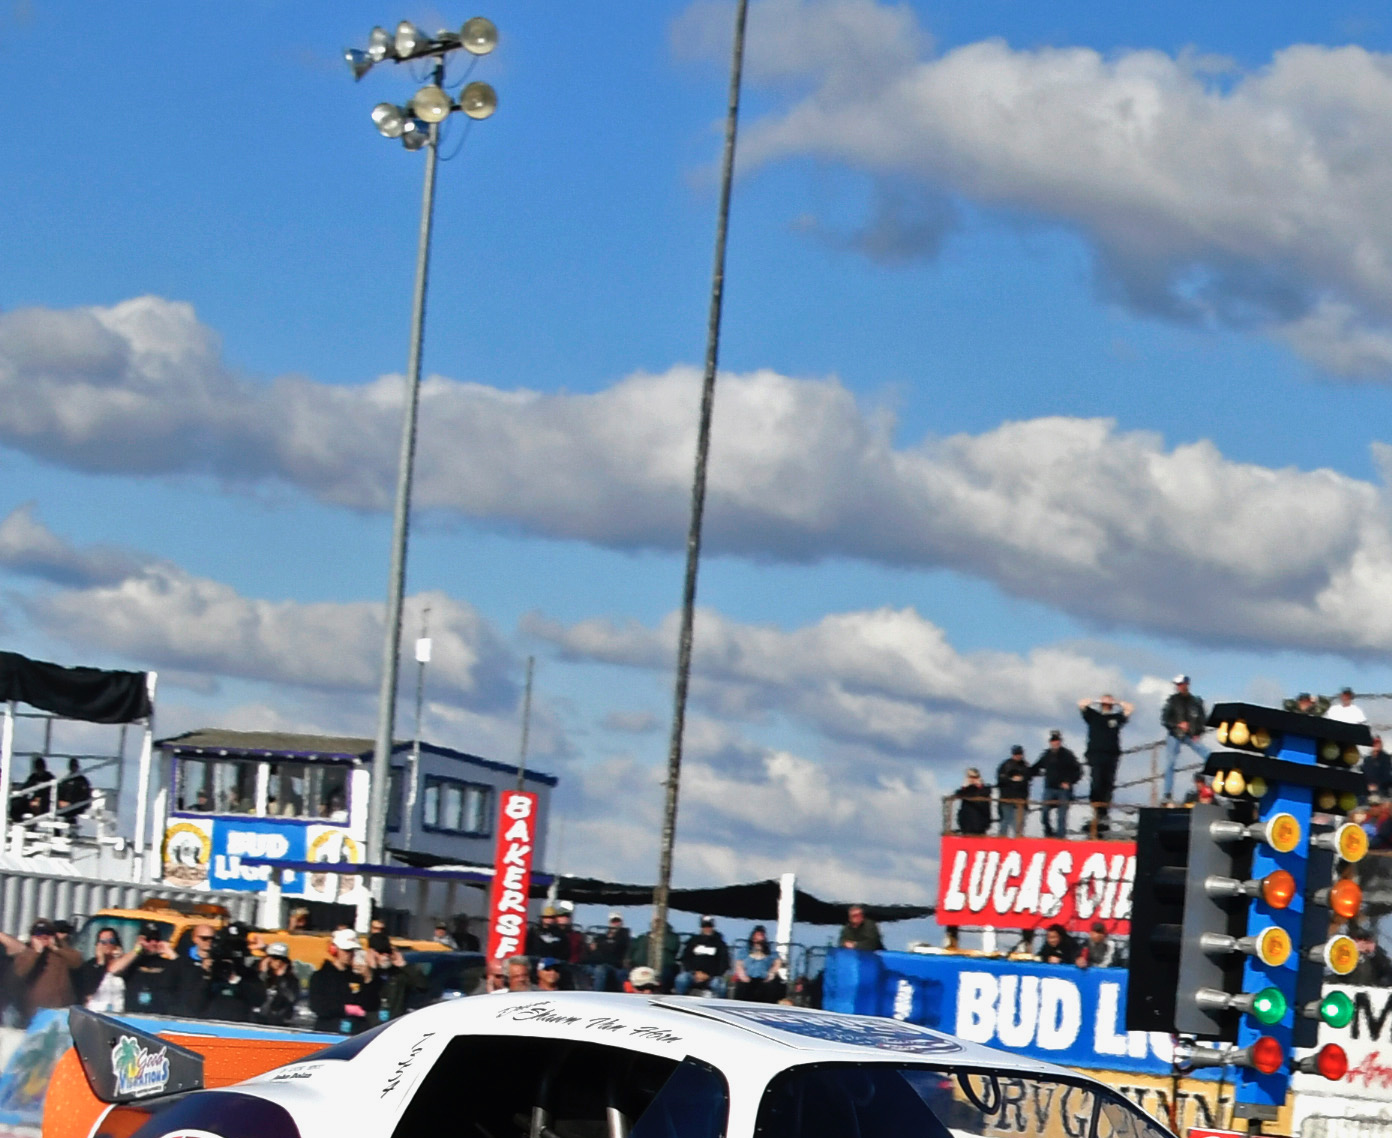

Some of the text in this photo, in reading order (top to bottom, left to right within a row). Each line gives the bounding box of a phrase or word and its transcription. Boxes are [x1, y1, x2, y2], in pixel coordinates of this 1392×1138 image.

[227, 830, 289, 859] BUD
[943, 850, 1073, 918] LUCAS
[955, 971, 1082, 1050] BUD
